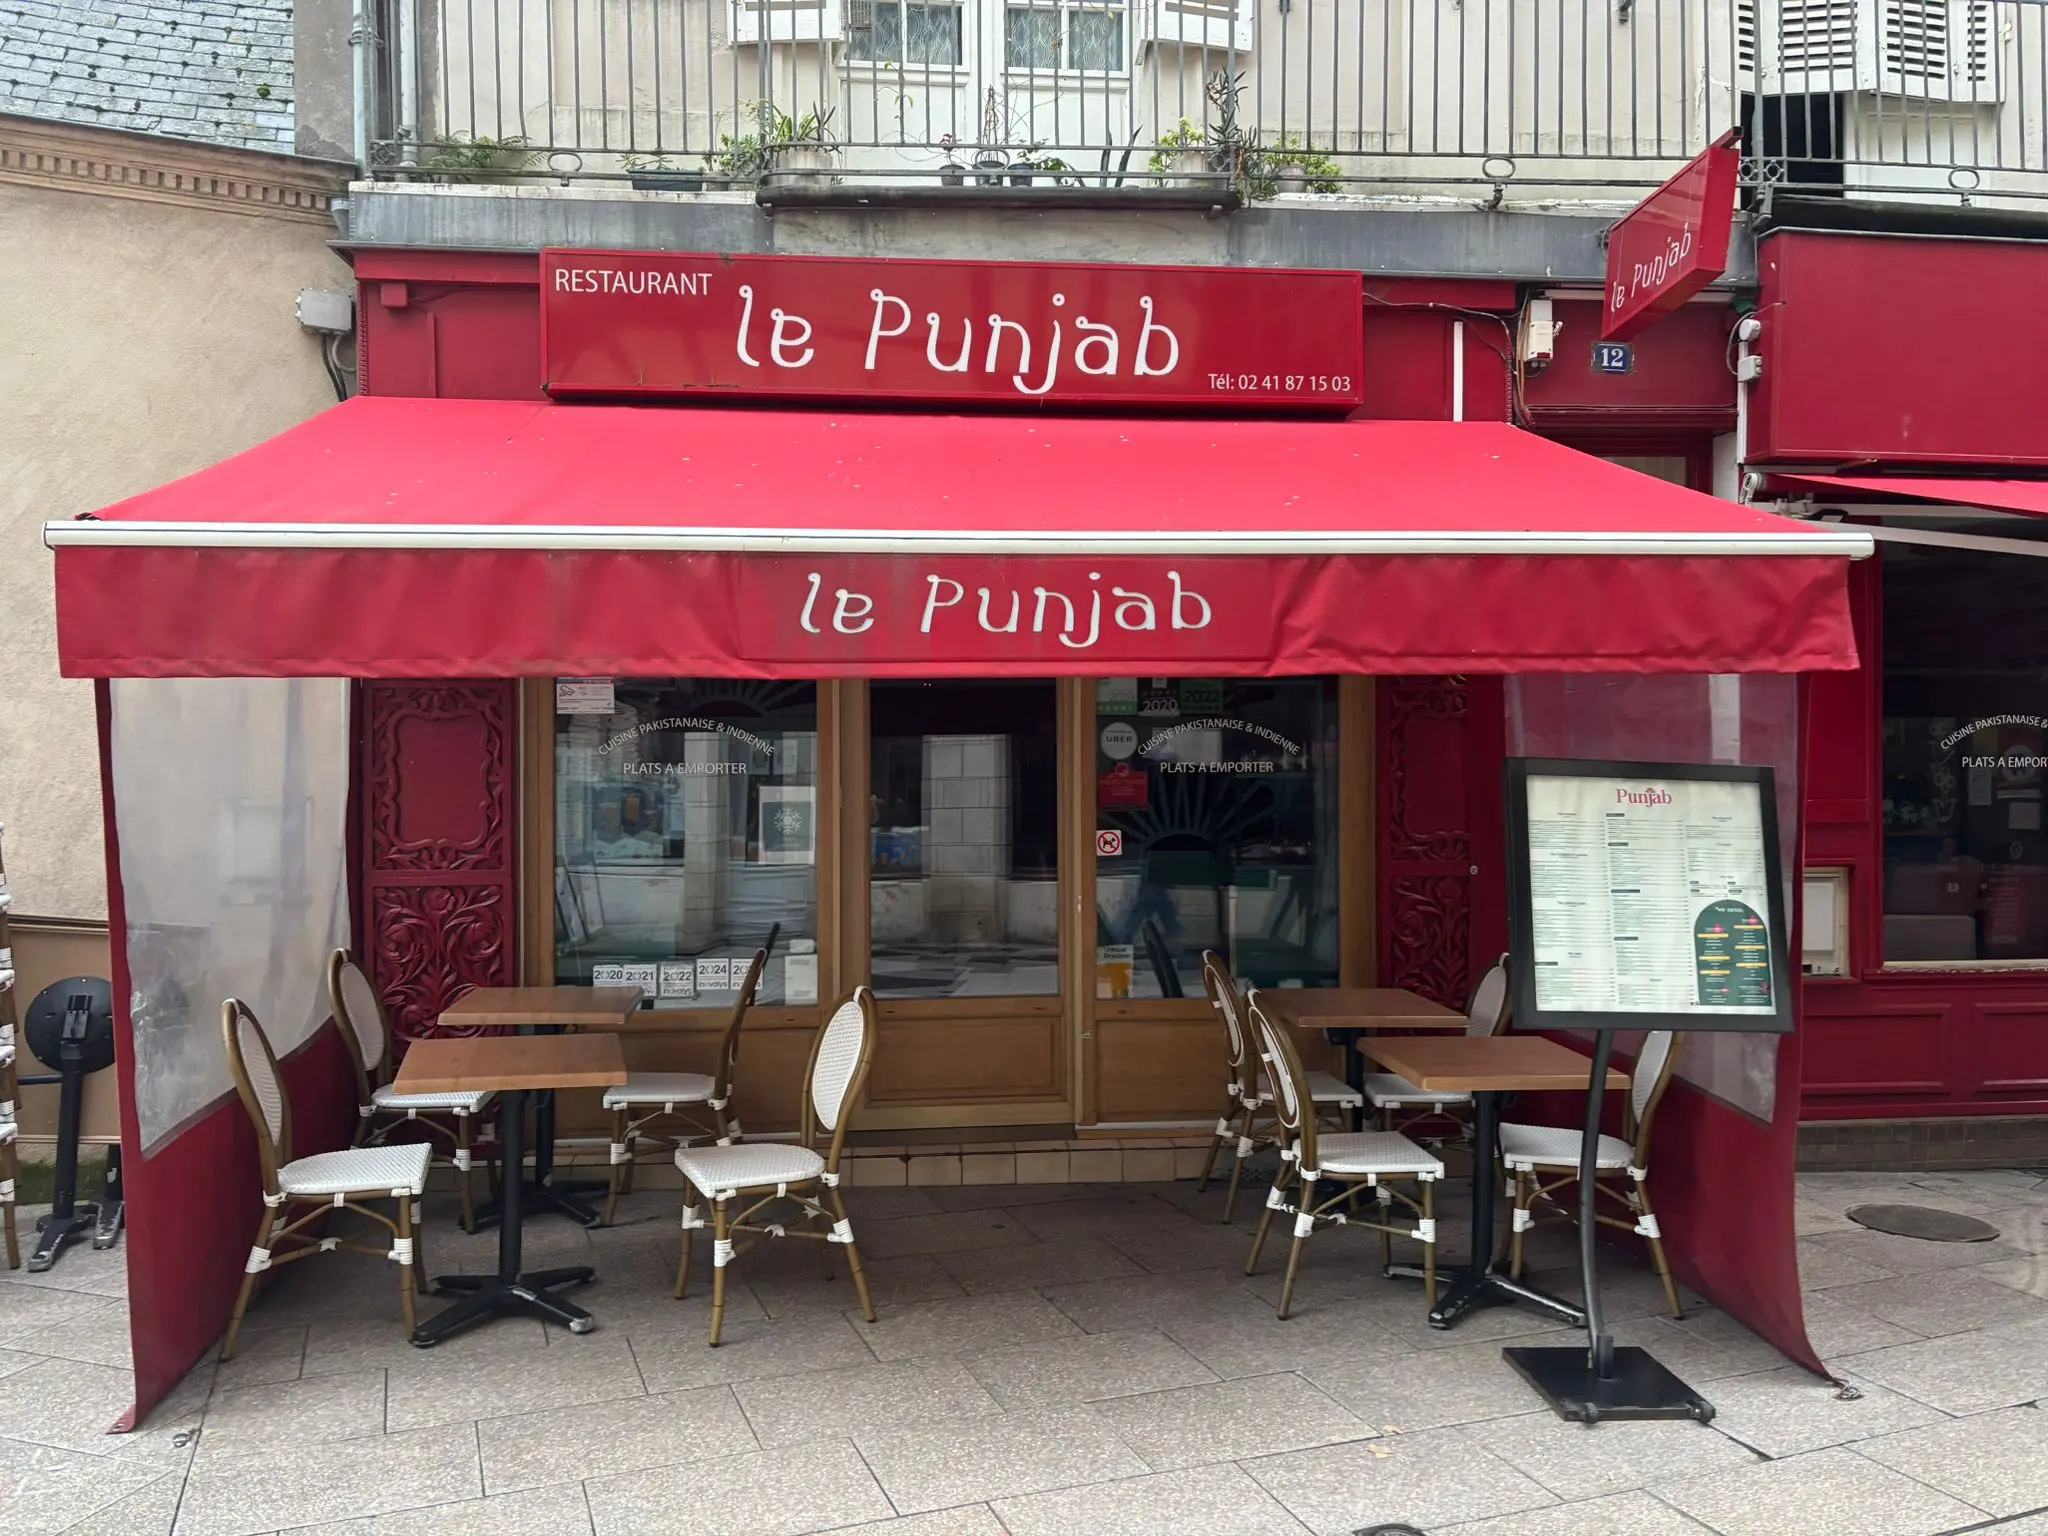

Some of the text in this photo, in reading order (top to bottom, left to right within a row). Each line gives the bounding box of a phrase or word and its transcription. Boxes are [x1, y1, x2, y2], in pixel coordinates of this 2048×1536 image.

[1610, 222, 1692, 313] le Punjab
[554, 268, 713, 299] RESTAURANT
[735, 285, 1181, 396] le Punjab
[1600, 348, 1624, 368] 12
[1208, 373, 1351, 391] Tél: 02 41 87 15 03
[799, 571, 1213, 649] le Punjab
[1142, 699, 1178, 713] 2020
[598, 717, 776, 758] CUISINE PAKISTANAISE & INDIENNE
[1105, 734, 1133, 743] UBER
[1137, 718, 1301, 757] CUISINE PAKISTANAISE & INDIENNE
[1940, 723, 1977, 750] CUISINE
[1974, 714, 2041, 730] PAKISTANAISE
[623, 762, 747, 775] PLATS A EMPORTER
[1160, 761, 1274, 774] PLATS A EMPORTER
[1961, 756, 2048, 768] PLATS A EMPOR
[1615, 787, 1673, 808] Punjab
[594, 970, 623, 980] 2020
[626, 970, 654, 981] 2021
[663, 971, 692, 982] 2022
[699, 964, 727, 975] 2024
